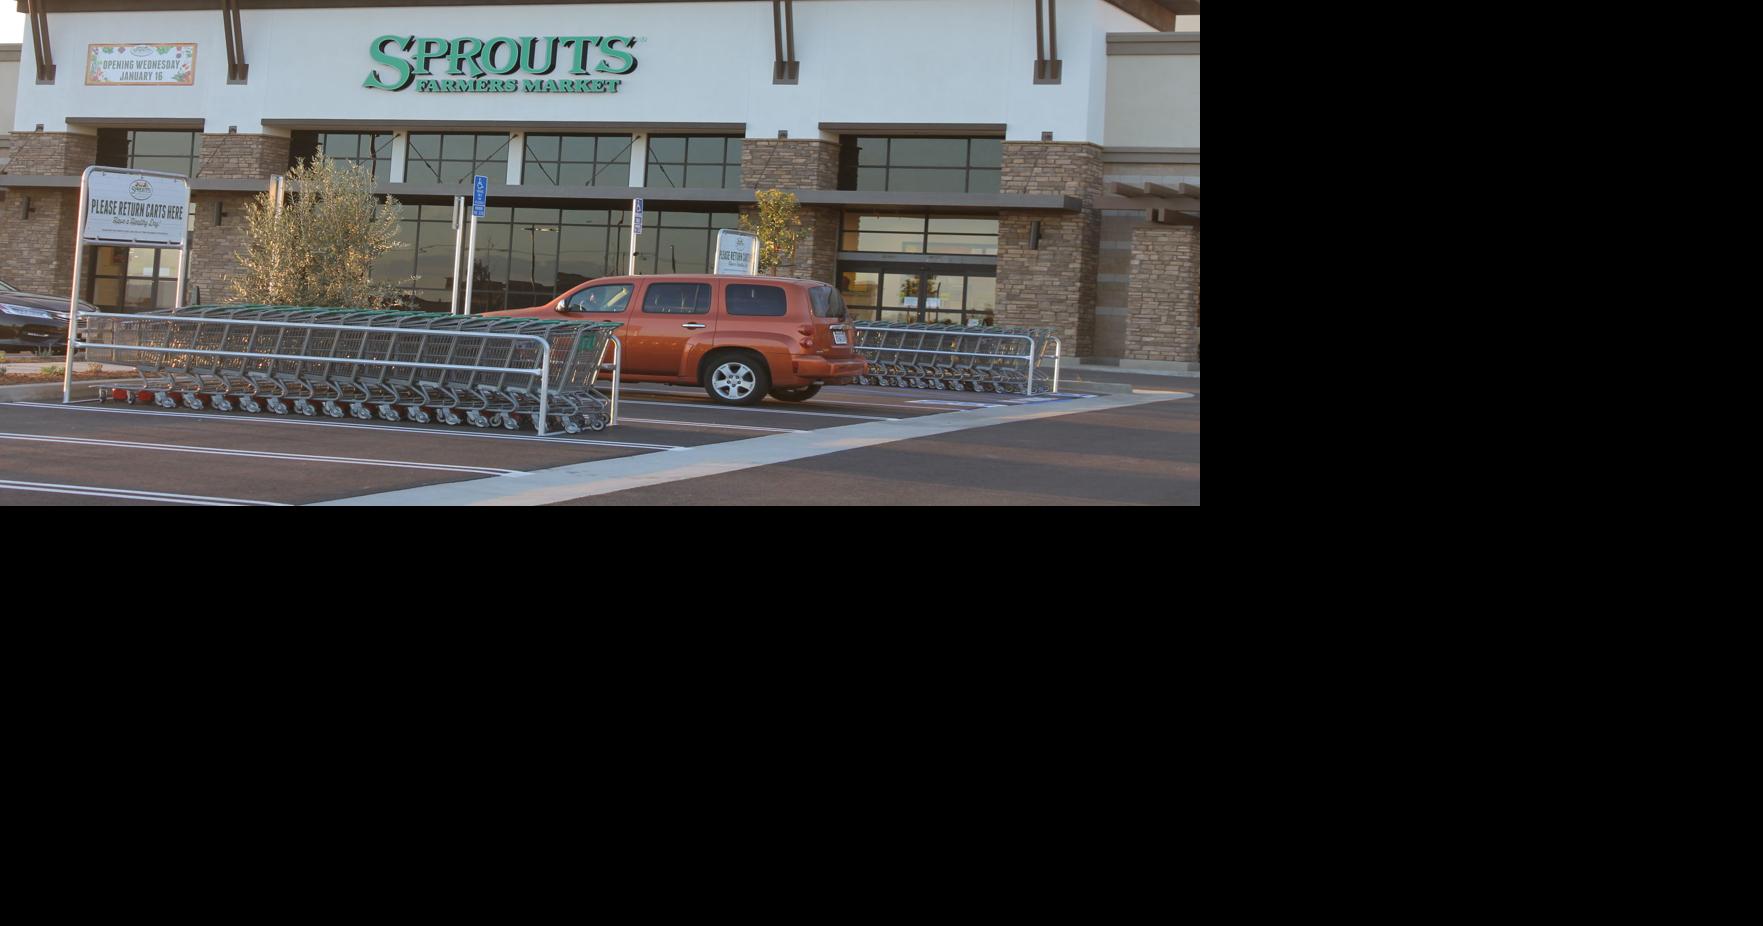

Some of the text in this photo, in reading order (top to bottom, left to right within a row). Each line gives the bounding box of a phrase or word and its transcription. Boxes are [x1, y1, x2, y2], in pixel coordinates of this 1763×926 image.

[103, 59, 134, 70] OPENING
[362, 34, 638, 92] SPROUTS
[119, 71, 163, 81] JANUARY 16
[414, 78, 622, 94] FARMERS MARKET
[91, 199, 183, 220] PLEASE RETURN CARTS HERE
[112, 216, 126, 225] Have
[130, 217, 148, 228] Healthy
